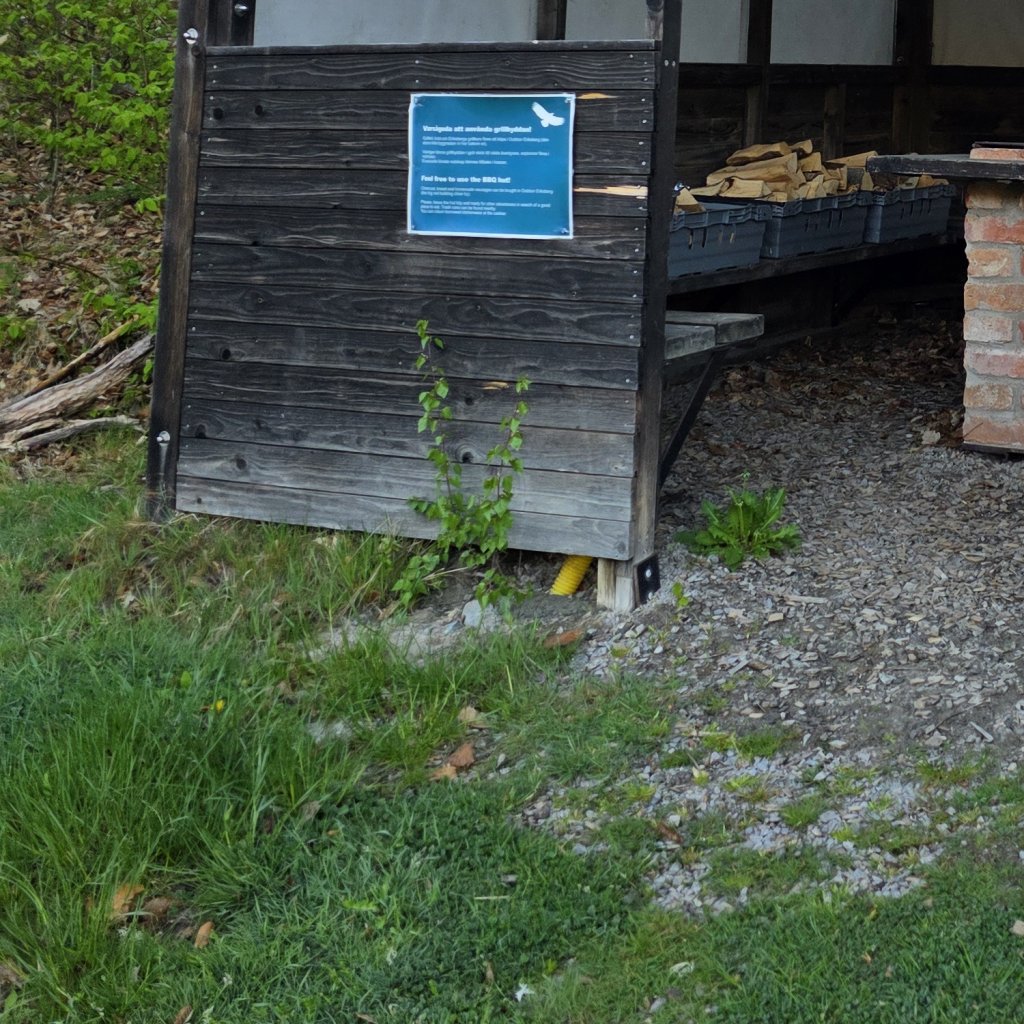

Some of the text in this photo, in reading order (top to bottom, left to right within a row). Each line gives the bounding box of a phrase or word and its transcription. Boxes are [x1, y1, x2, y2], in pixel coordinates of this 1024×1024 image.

[421, 175, 434, 183] Feel
[434, 175, 447, 183] free
[482, 176, 497, 184] BBQ
